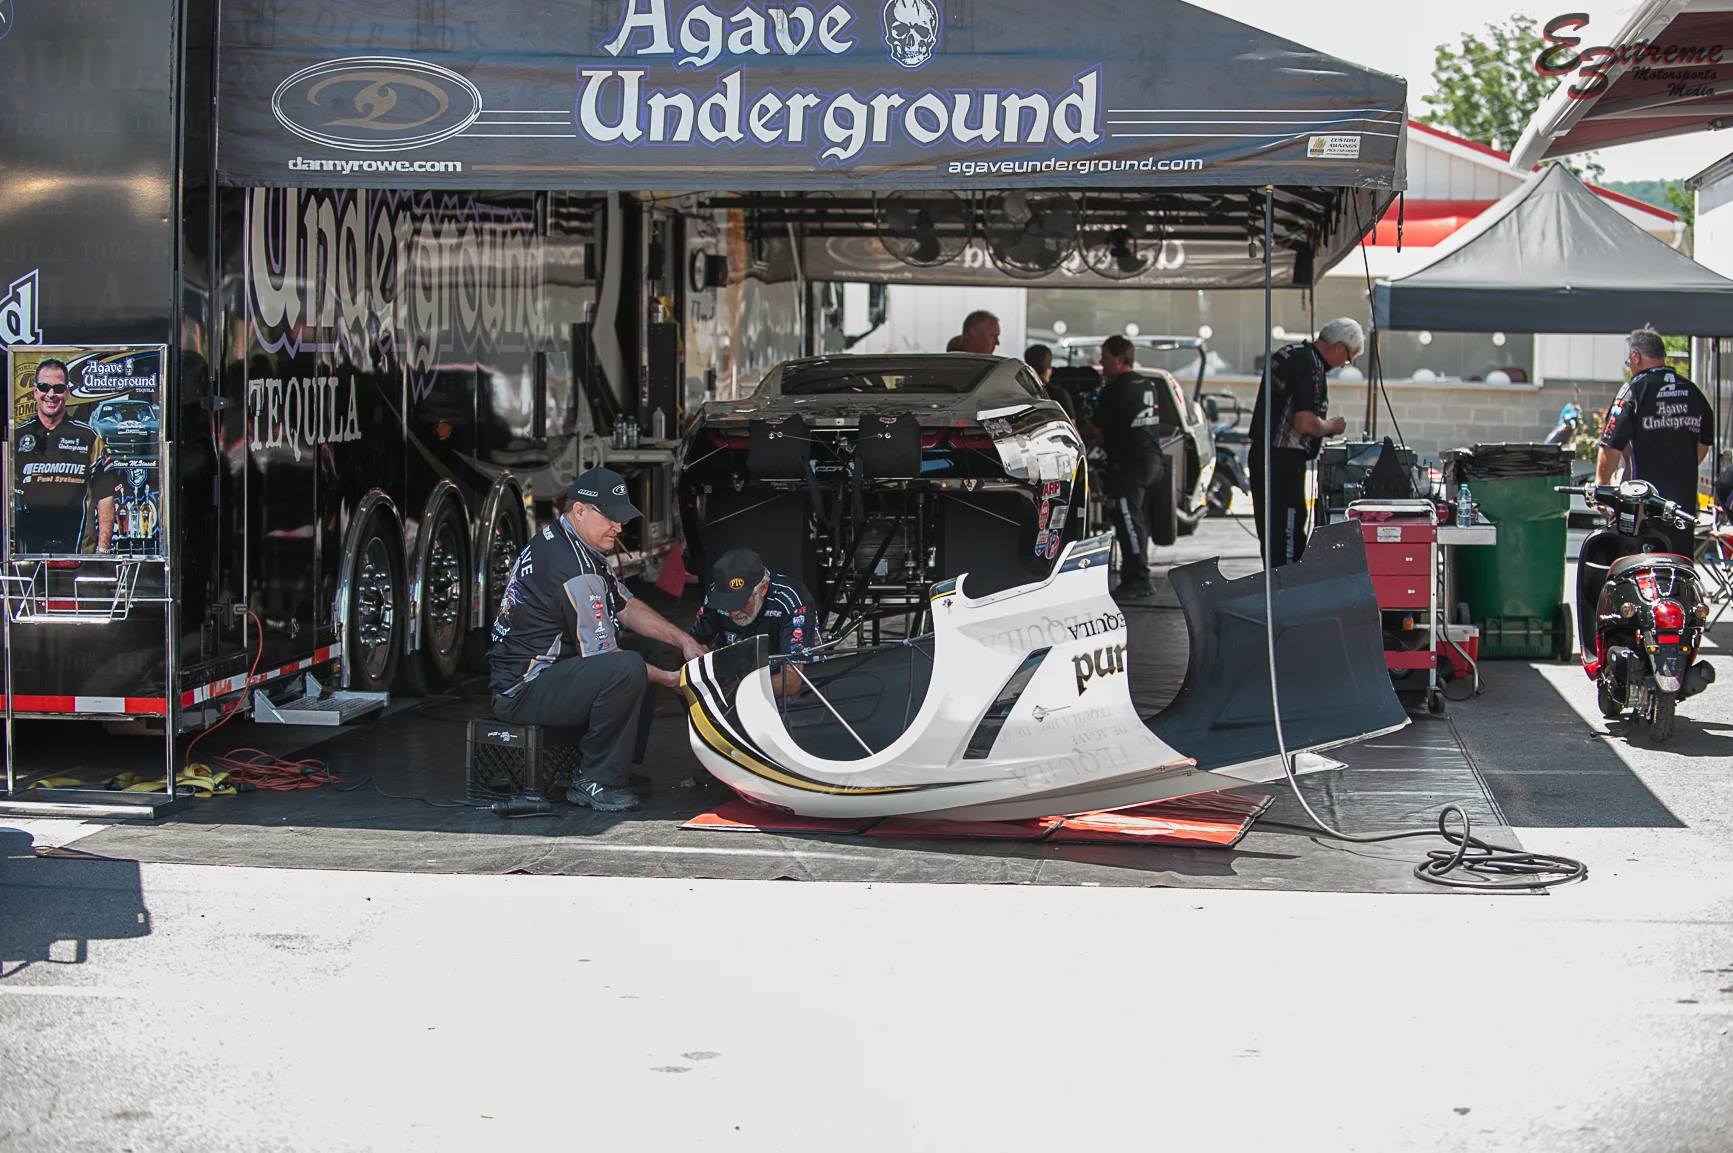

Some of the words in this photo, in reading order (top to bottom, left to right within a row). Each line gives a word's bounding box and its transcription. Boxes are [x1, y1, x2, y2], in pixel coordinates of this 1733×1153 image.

[603, 0, 853, 67] Agave
[579, 70, 1100, 161] Underground
[288, 156, 462, 175] dannyrowe.com
[948, 157, 1203, 176] agaveunderground.com
[250, 187, 546, 374] Underground
[86, 359, 124, 374] Agave
[84, 373, 156, 389] Underground
[248, 375, 362, 462] TEQUILA
[1043, 480, 1060, 497] ARP
[730, 579, 744, 588] PTC
